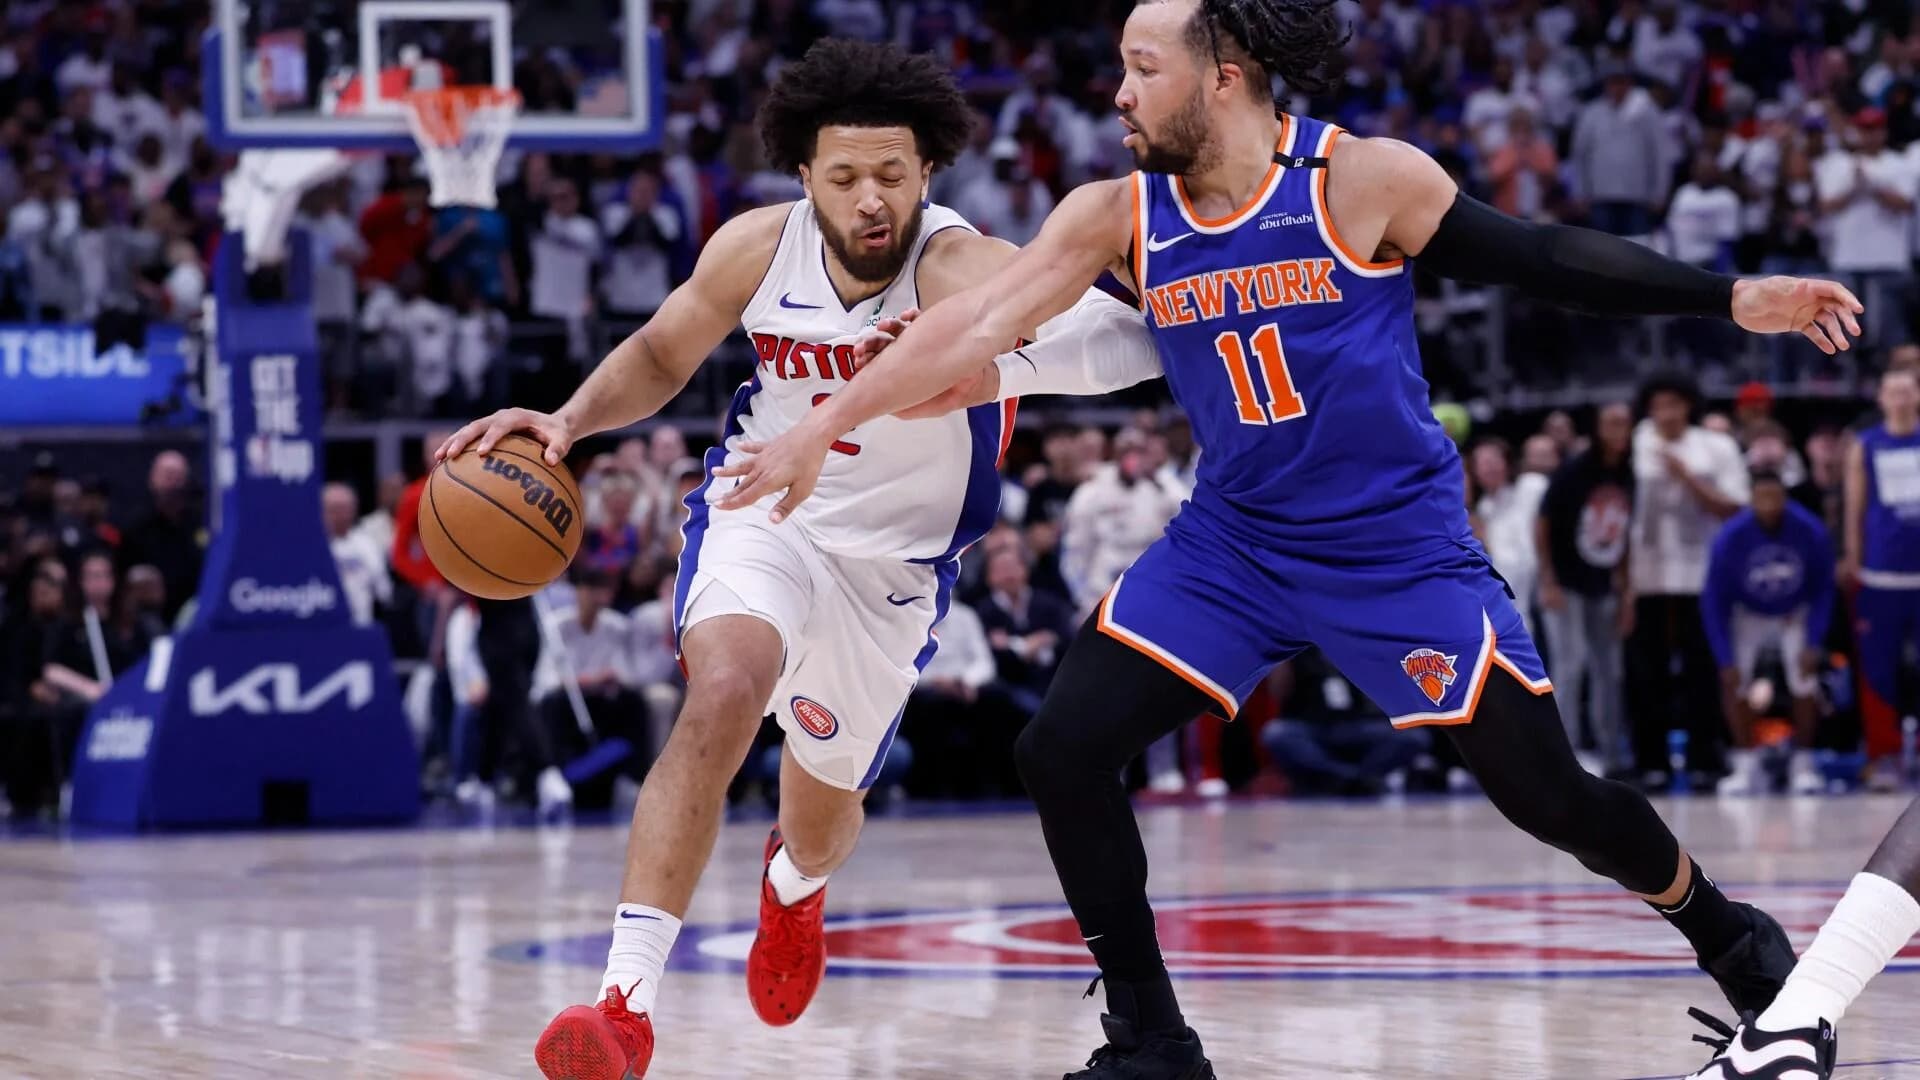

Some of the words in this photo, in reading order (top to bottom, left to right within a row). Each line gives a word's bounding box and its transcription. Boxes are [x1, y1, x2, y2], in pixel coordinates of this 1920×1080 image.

[1258, 219, 1280, 231] abu
[1281, 212, 1314, 226] dhabi
[752, 331, 857, 382] PISTO
[1214, 322, 1307, 426] 11
[483, 455, 573, 539] Wilson
[229, 577, 336, 618] Google
[189, 661, 374, 715] KIA
[1407, 653, 1455, 678] KNICKS
